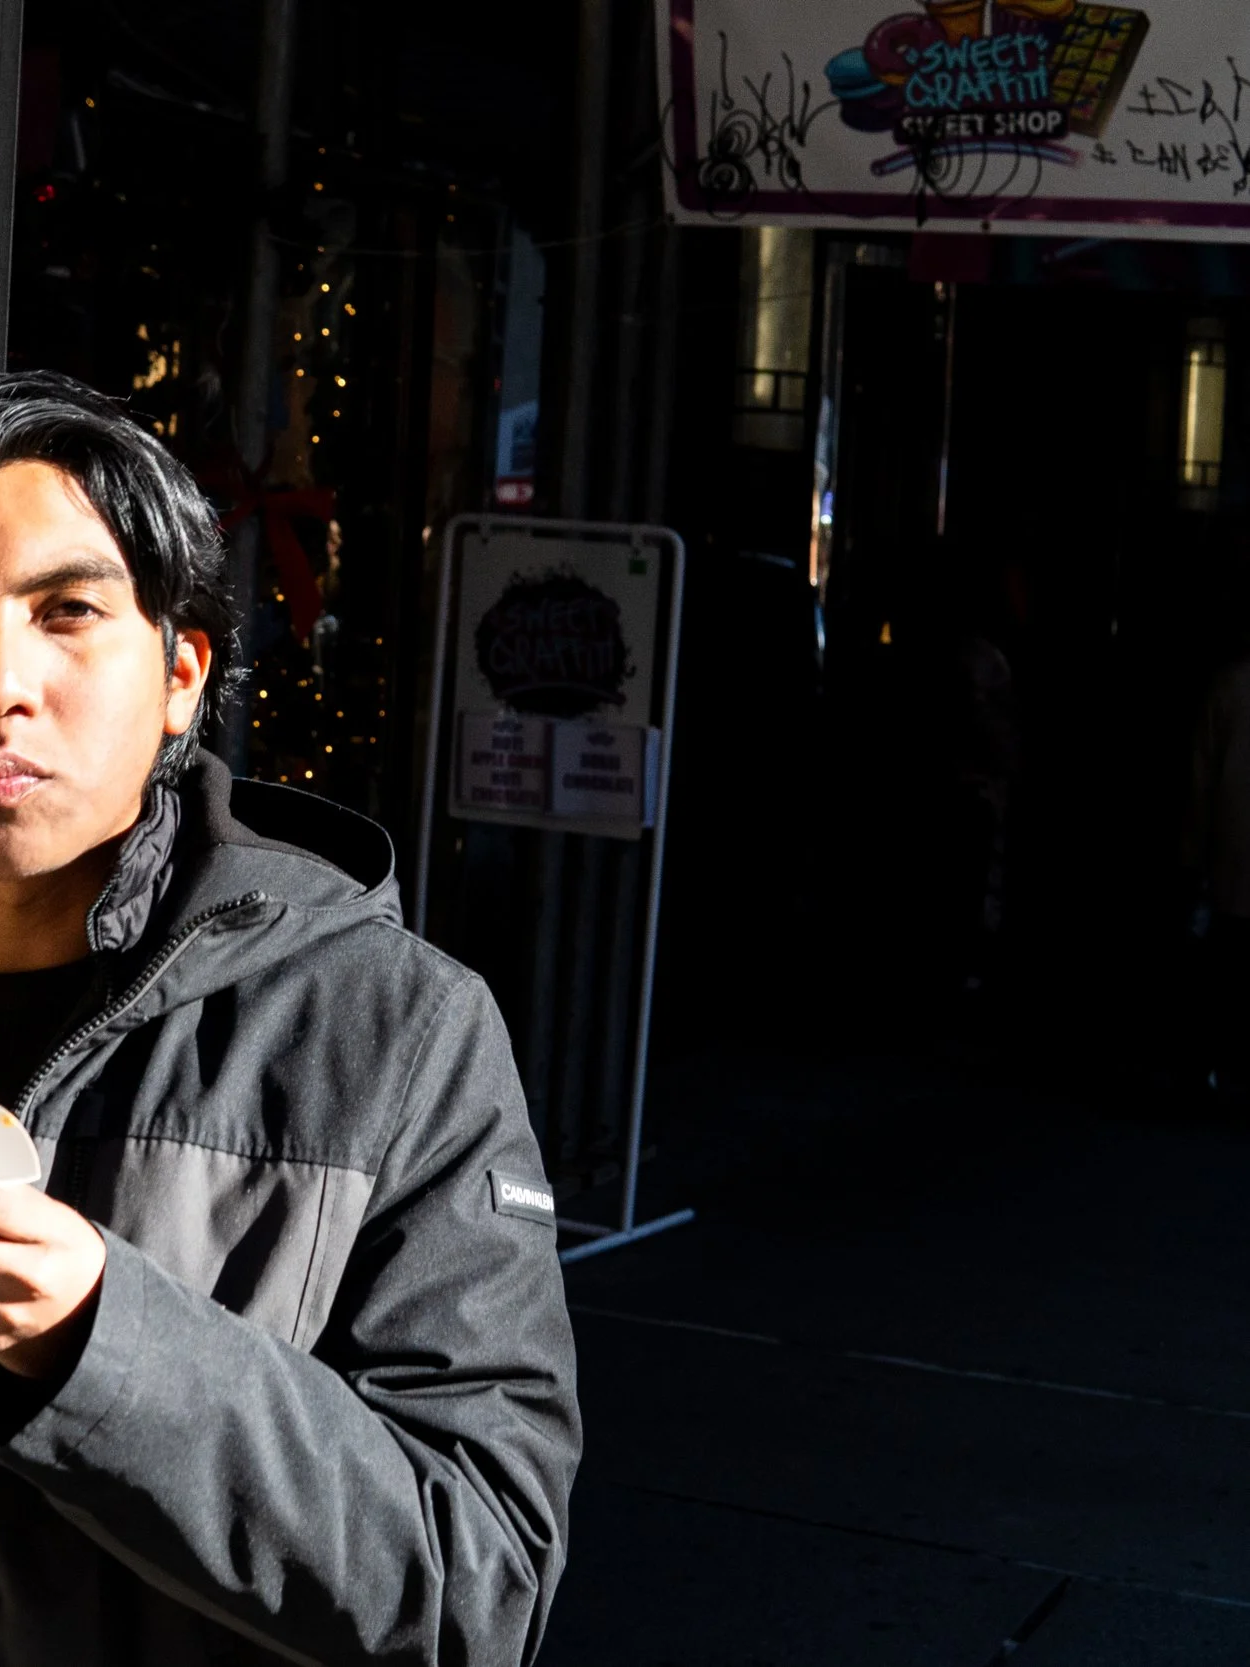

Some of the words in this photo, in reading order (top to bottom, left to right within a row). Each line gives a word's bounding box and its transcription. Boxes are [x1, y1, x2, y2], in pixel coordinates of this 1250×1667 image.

[917, 31, 1035, 74] SWEET
[903, 55, 1050, 110] GRAFFITI
[992, 109, 1064, 137] SHOP
[502, 597, 606, 635] SWEET
[488, 633, 616, 681] GRAFFITI
